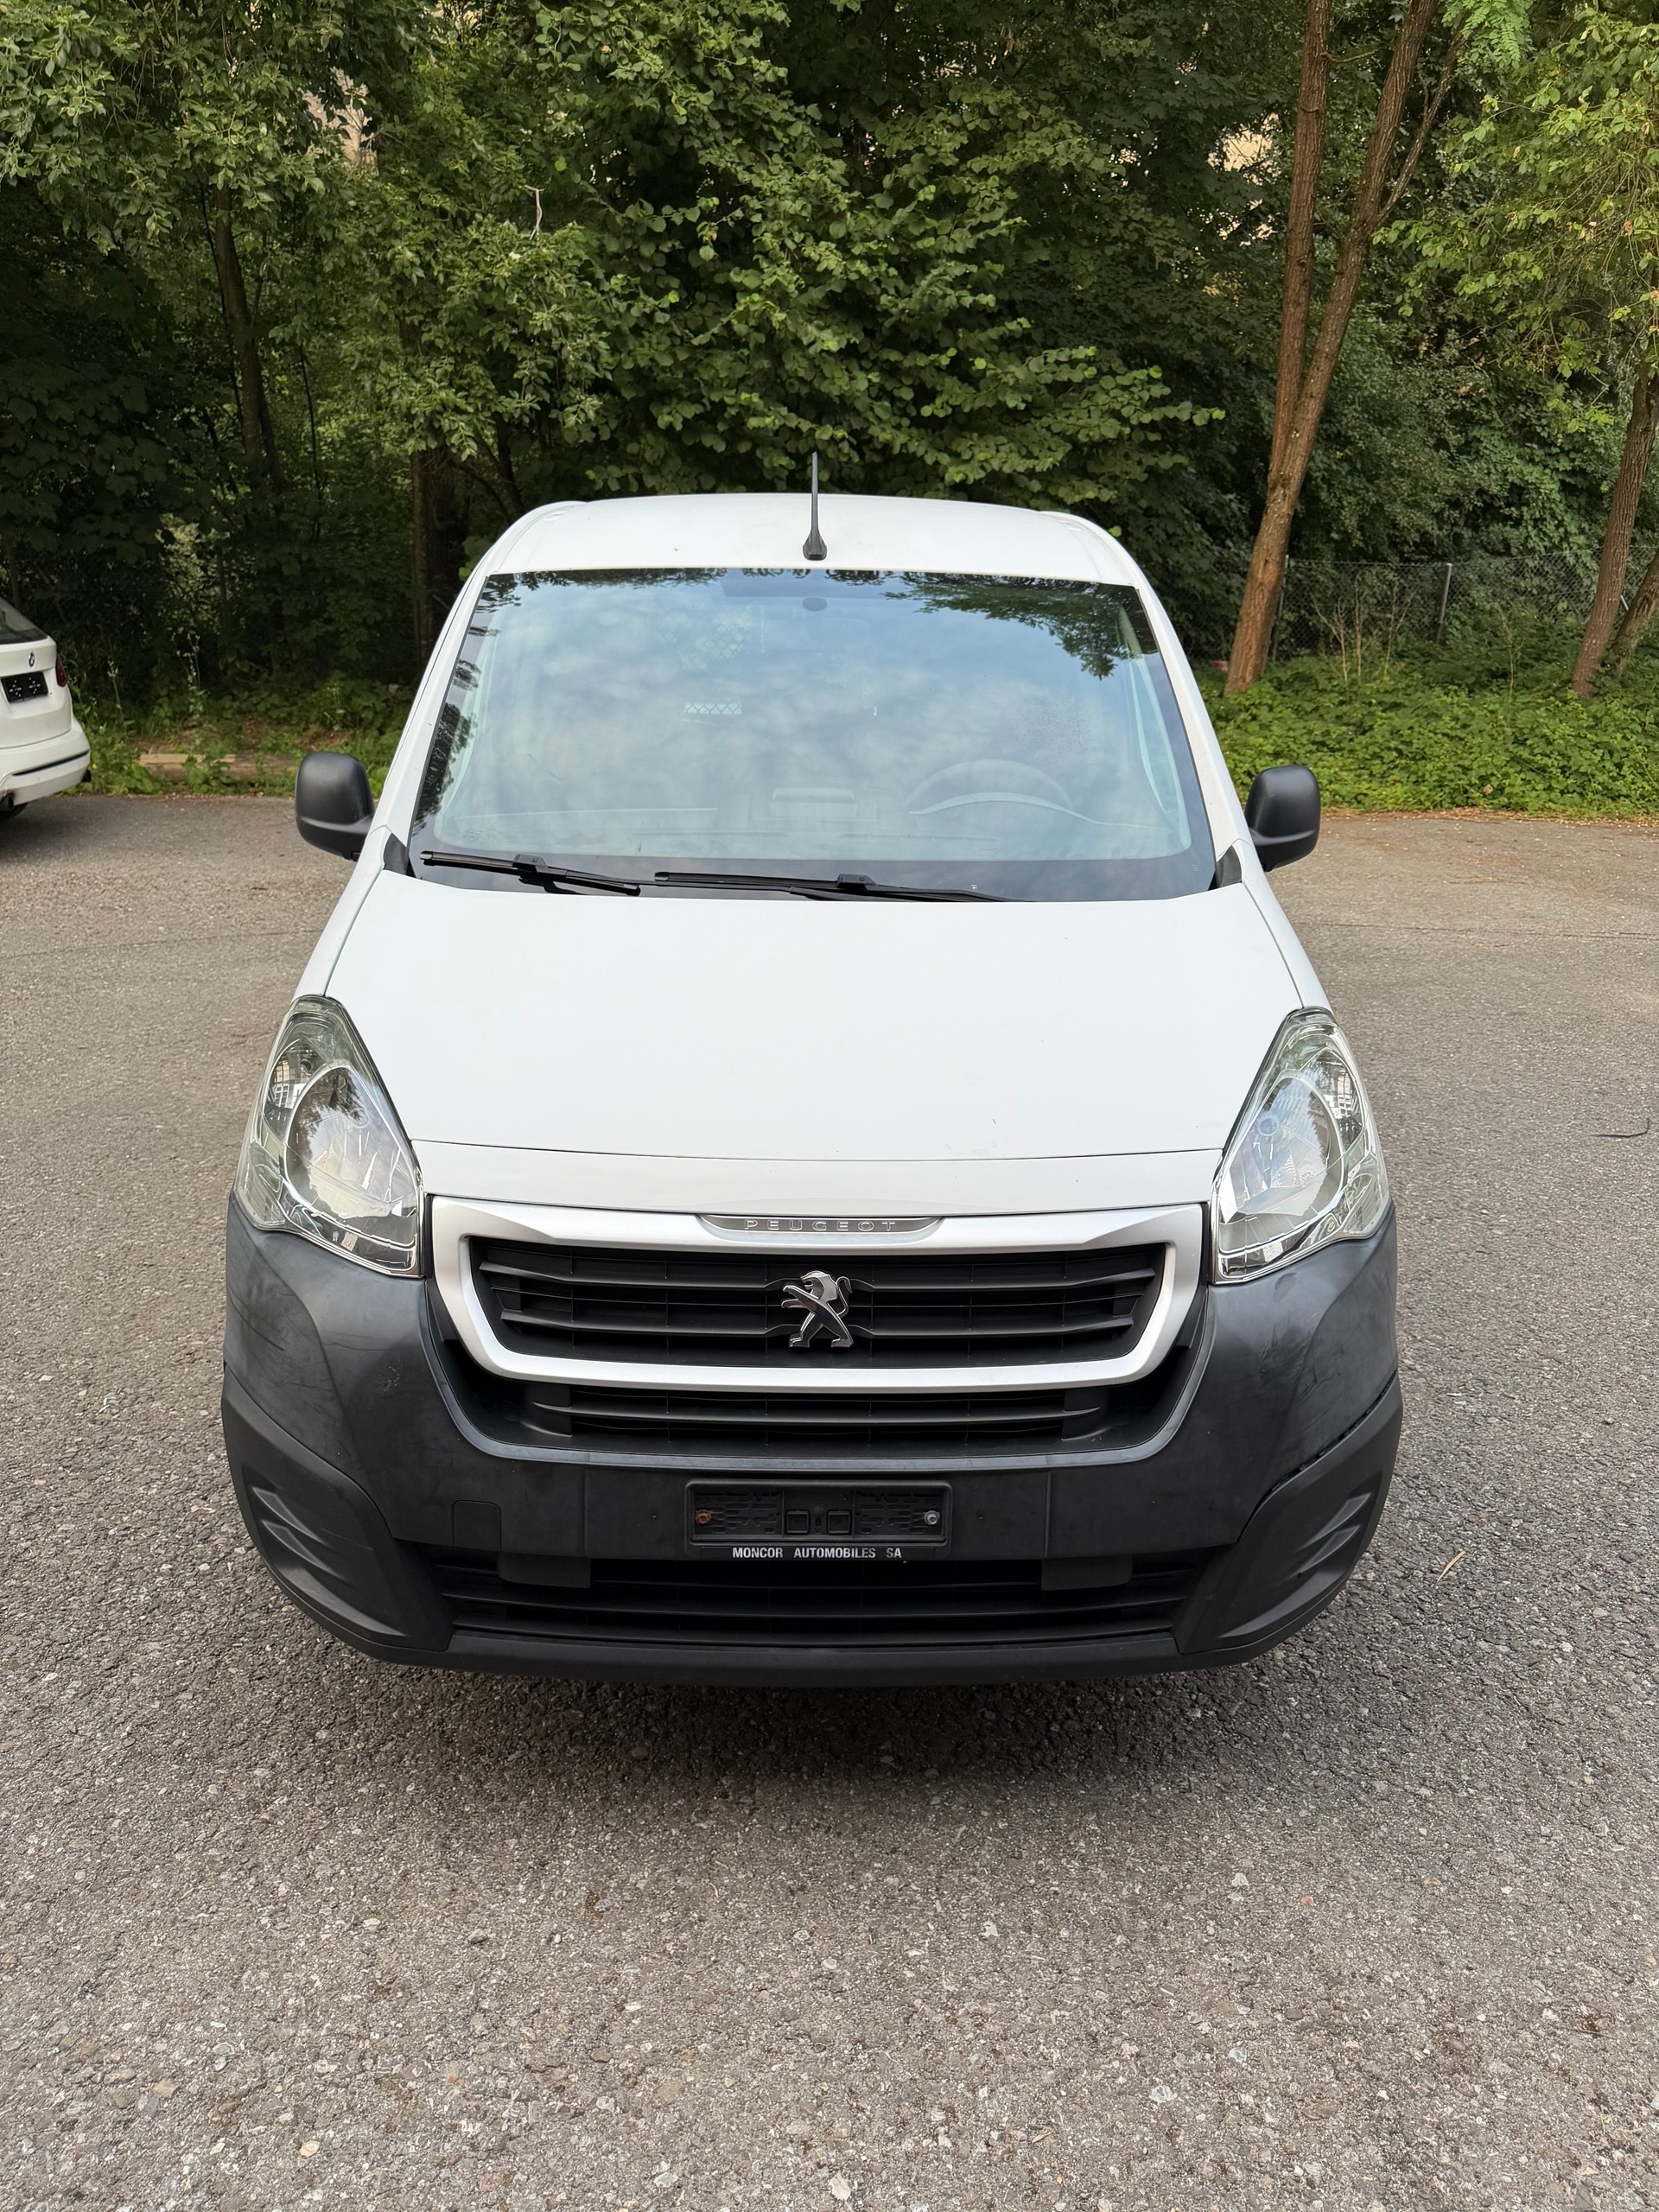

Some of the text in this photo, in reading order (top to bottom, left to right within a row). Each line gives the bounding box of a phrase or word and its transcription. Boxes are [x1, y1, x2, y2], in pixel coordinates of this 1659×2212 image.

[744, 1219, 895, 1231] PEUGEOT
[732, 1547, 902, 1559] MONCOR AUTOMOBILES SA
